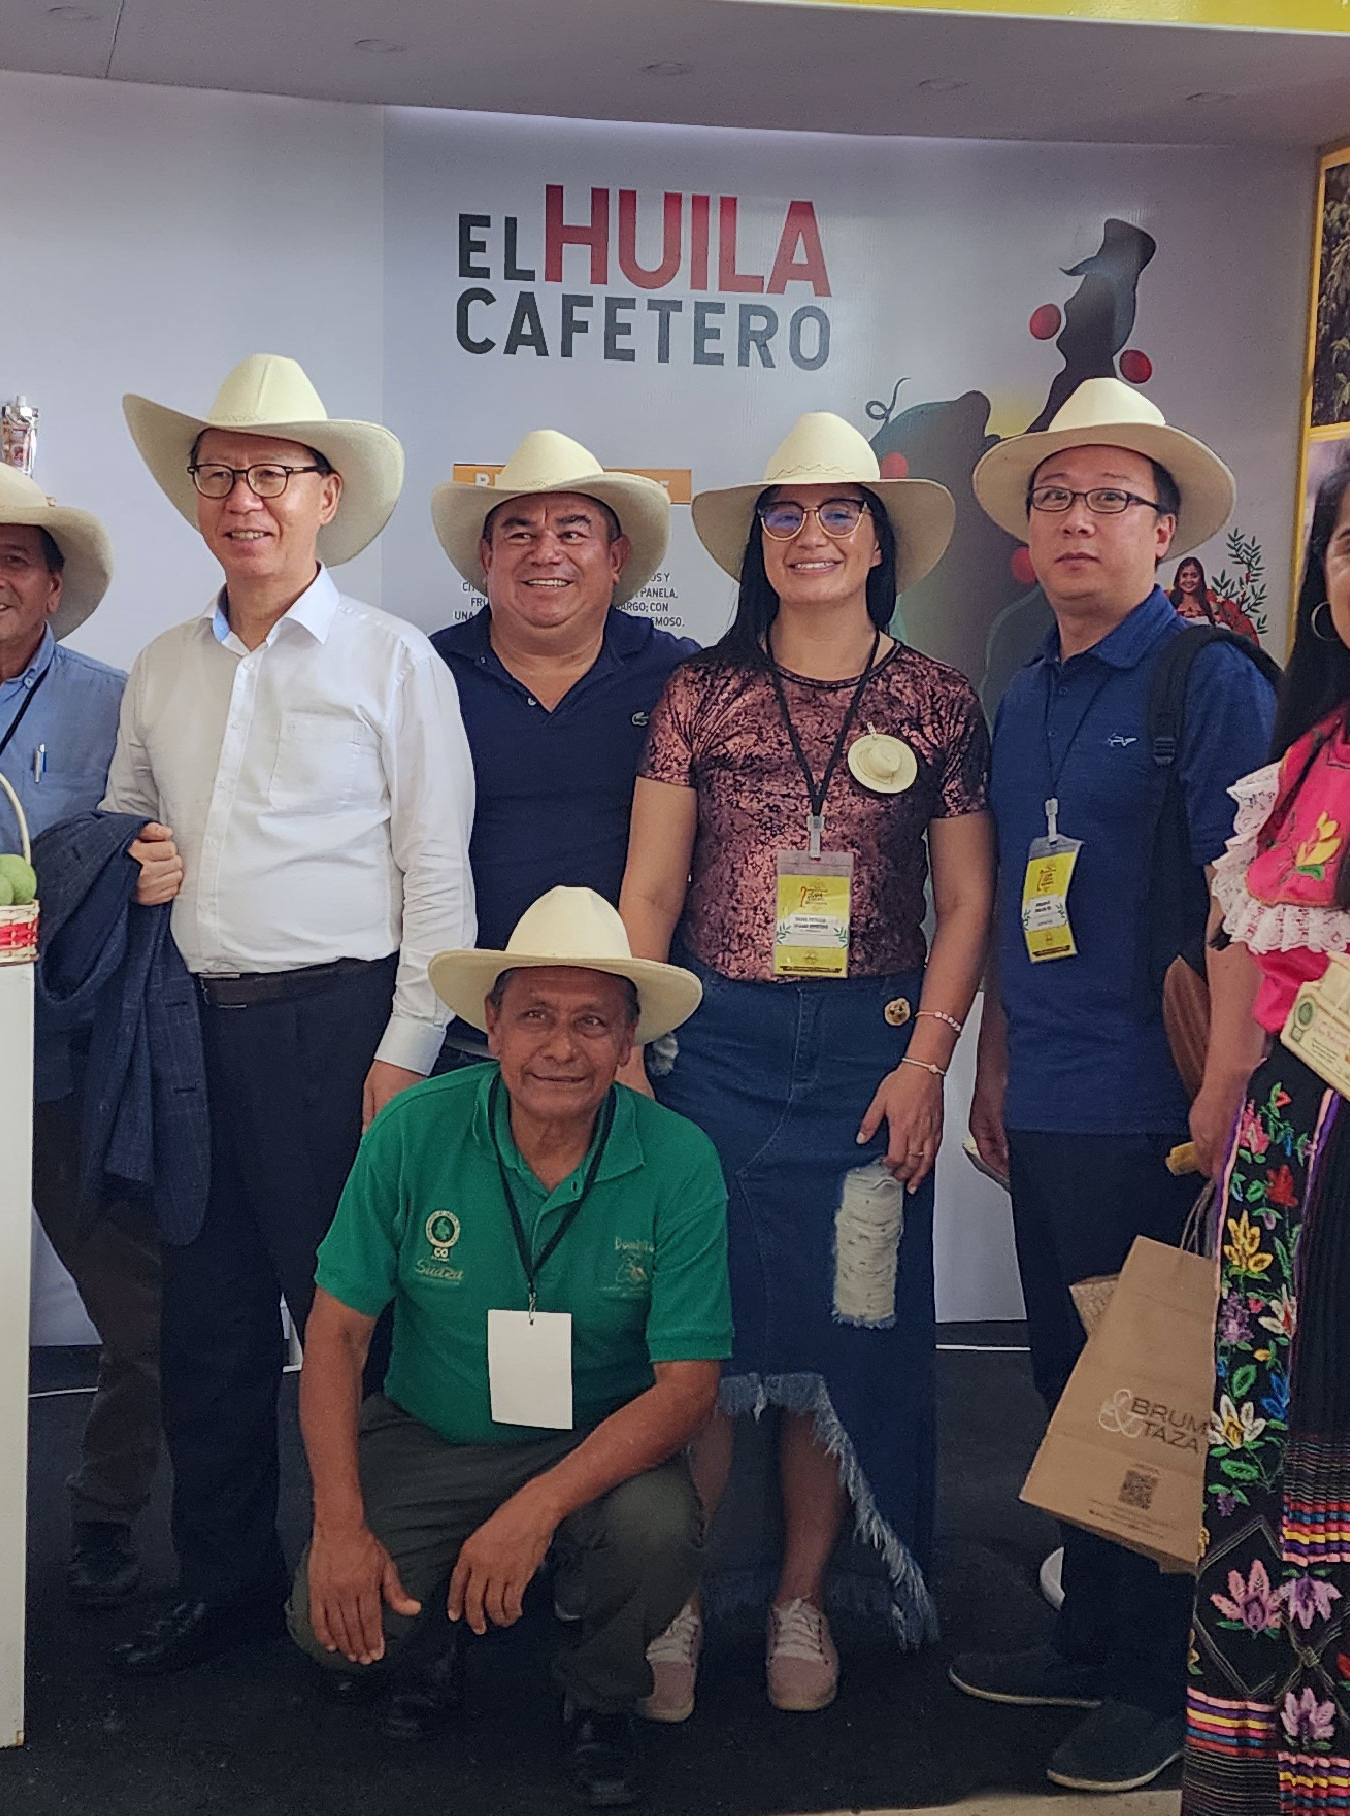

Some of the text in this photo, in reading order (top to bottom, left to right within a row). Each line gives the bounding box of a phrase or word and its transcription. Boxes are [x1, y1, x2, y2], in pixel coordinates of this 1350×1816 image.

[458, 184, 832, 297] EL HUILA
[456, 287, 831, 371] CAFETERO
[650, 602, 669, 612] CON
[1144, 1420, 1199, 1453] TAZA
